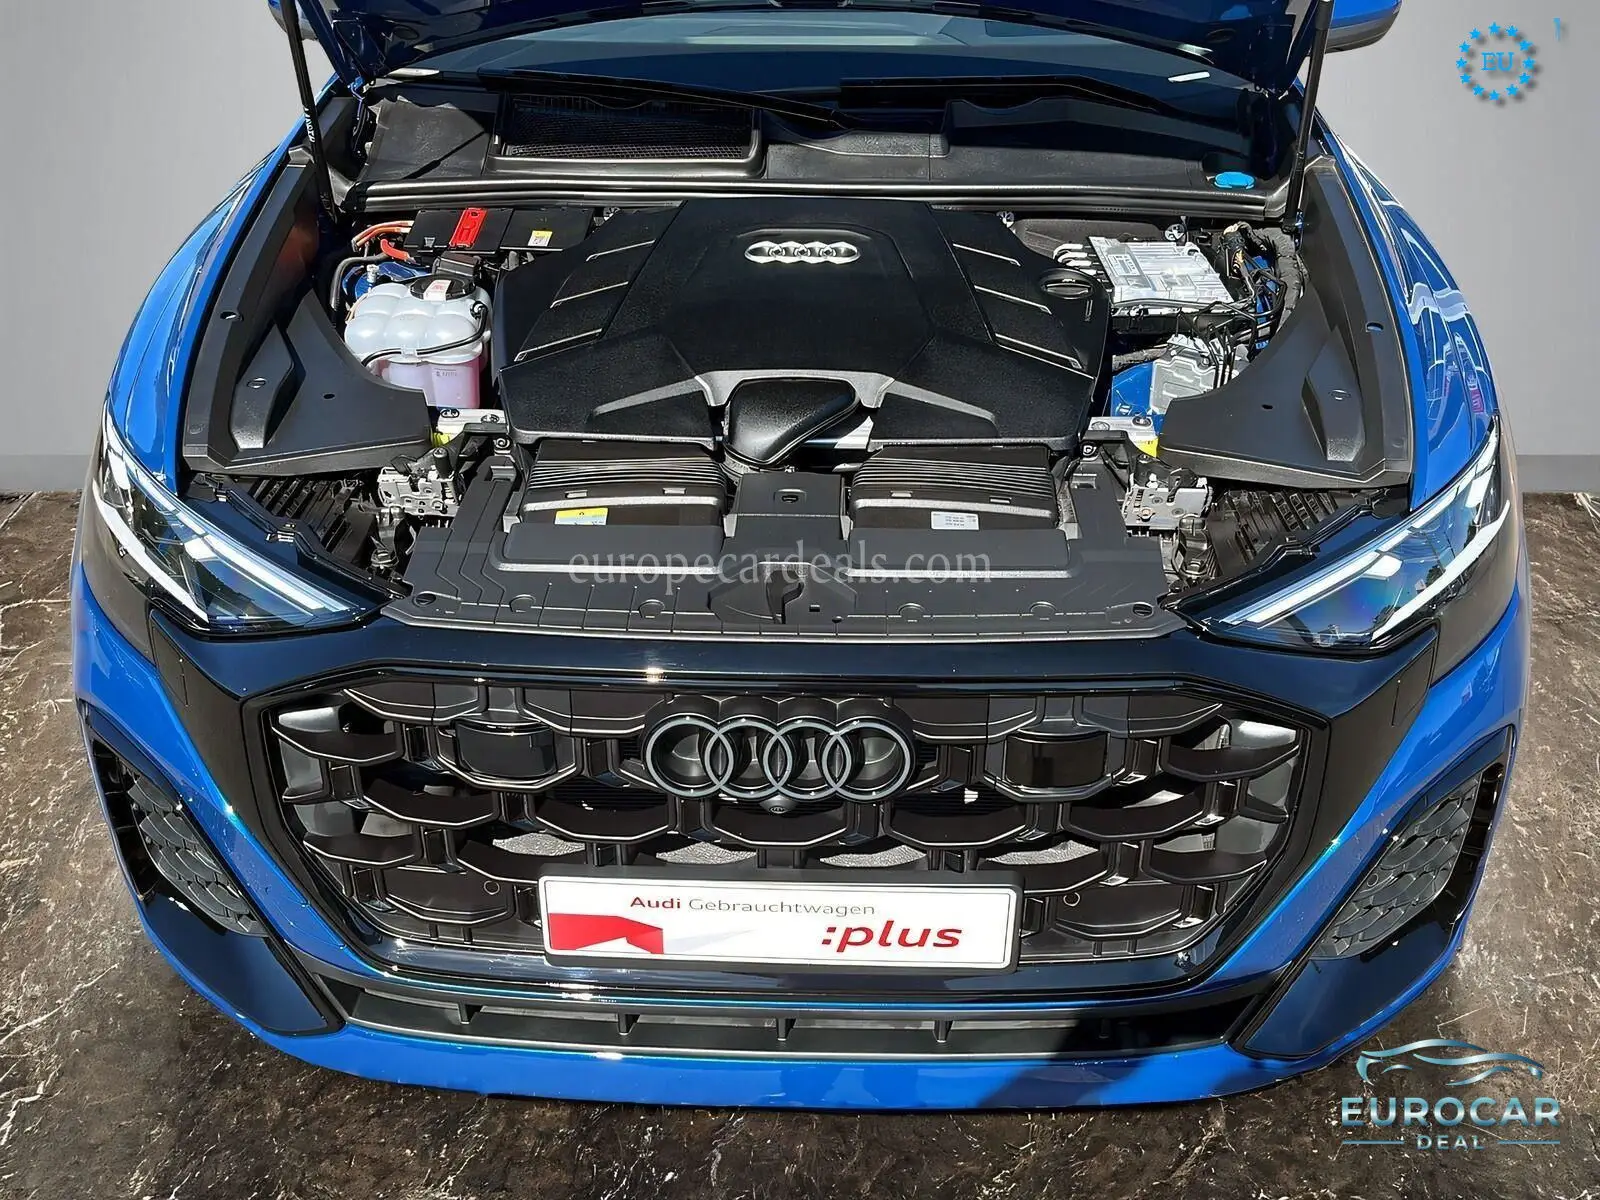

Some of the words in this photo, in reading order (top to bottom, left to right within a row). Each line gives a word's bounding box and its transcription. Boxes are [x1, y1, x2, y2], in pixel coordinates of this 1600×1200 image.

[630, 896, 682, 910] Audi
[688, 897, 876, 918] Gebrauchtwagen
[821, 920, 963, 953] :plus
